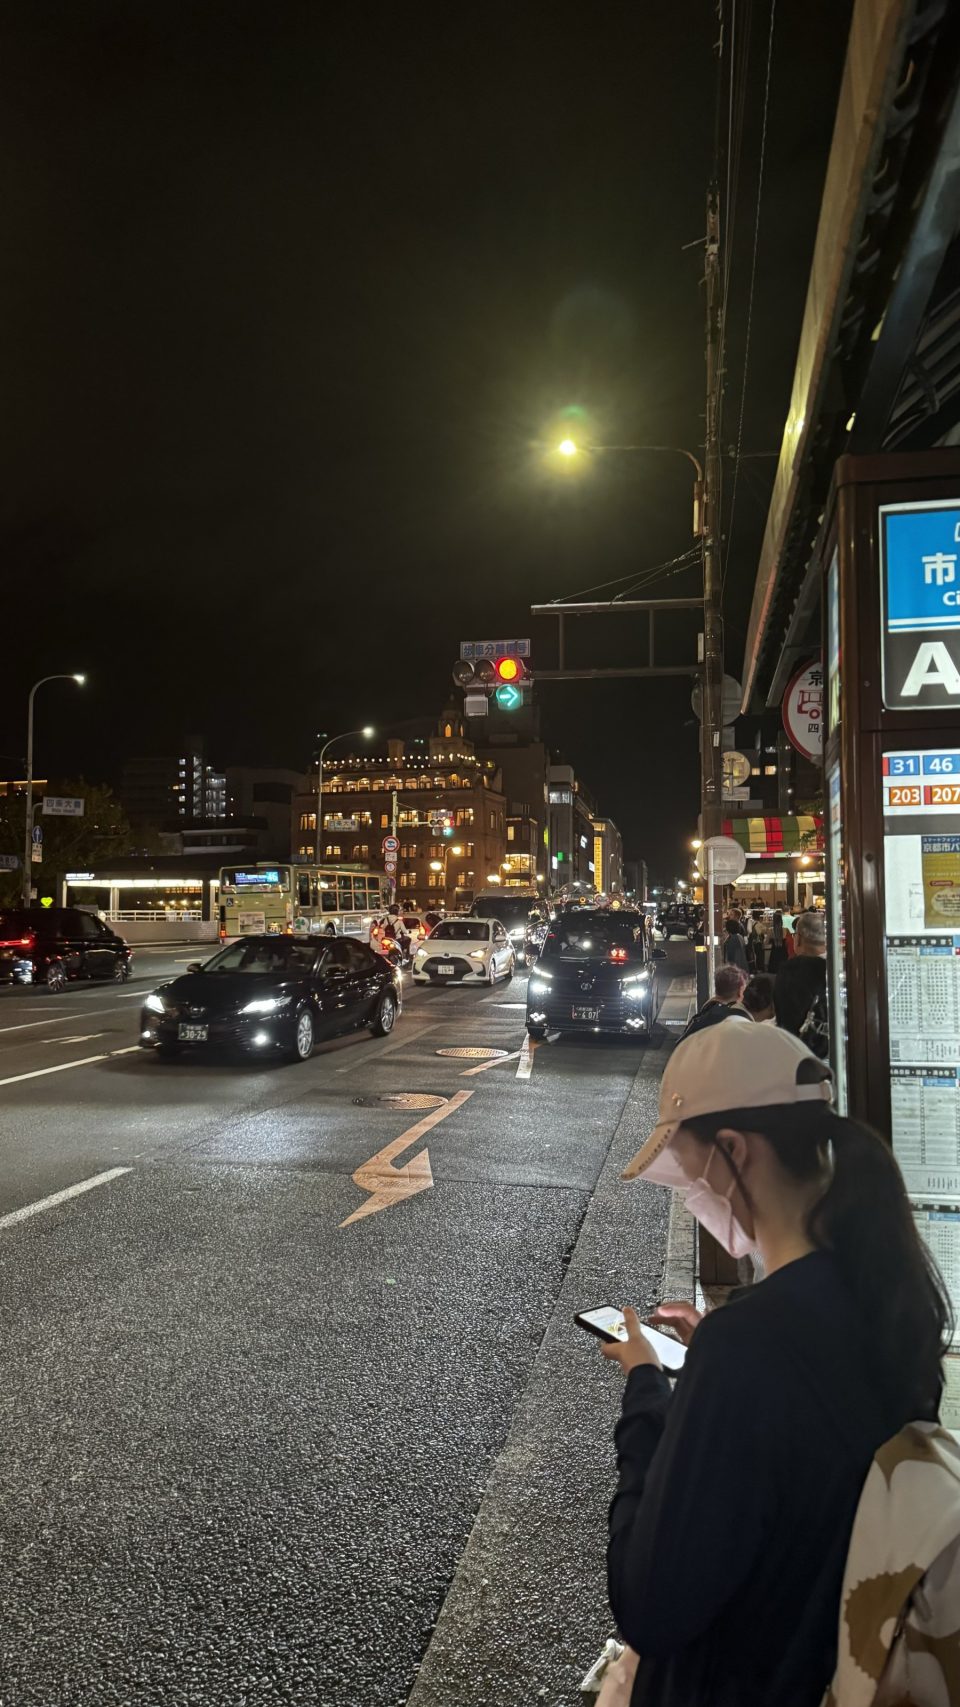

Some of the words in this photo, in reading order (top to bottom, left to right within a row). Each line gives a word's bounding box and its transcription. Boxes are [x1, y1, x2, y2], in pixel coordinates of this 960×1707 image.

[921, 552, 958, 586] 市
[900, 642, 960, 697] A
[893, 758, 915, 774] 31
[929, 757, 953, 772] 46
[891, 788, 920, 803] 203
[932, 787, 960, 802] 207
